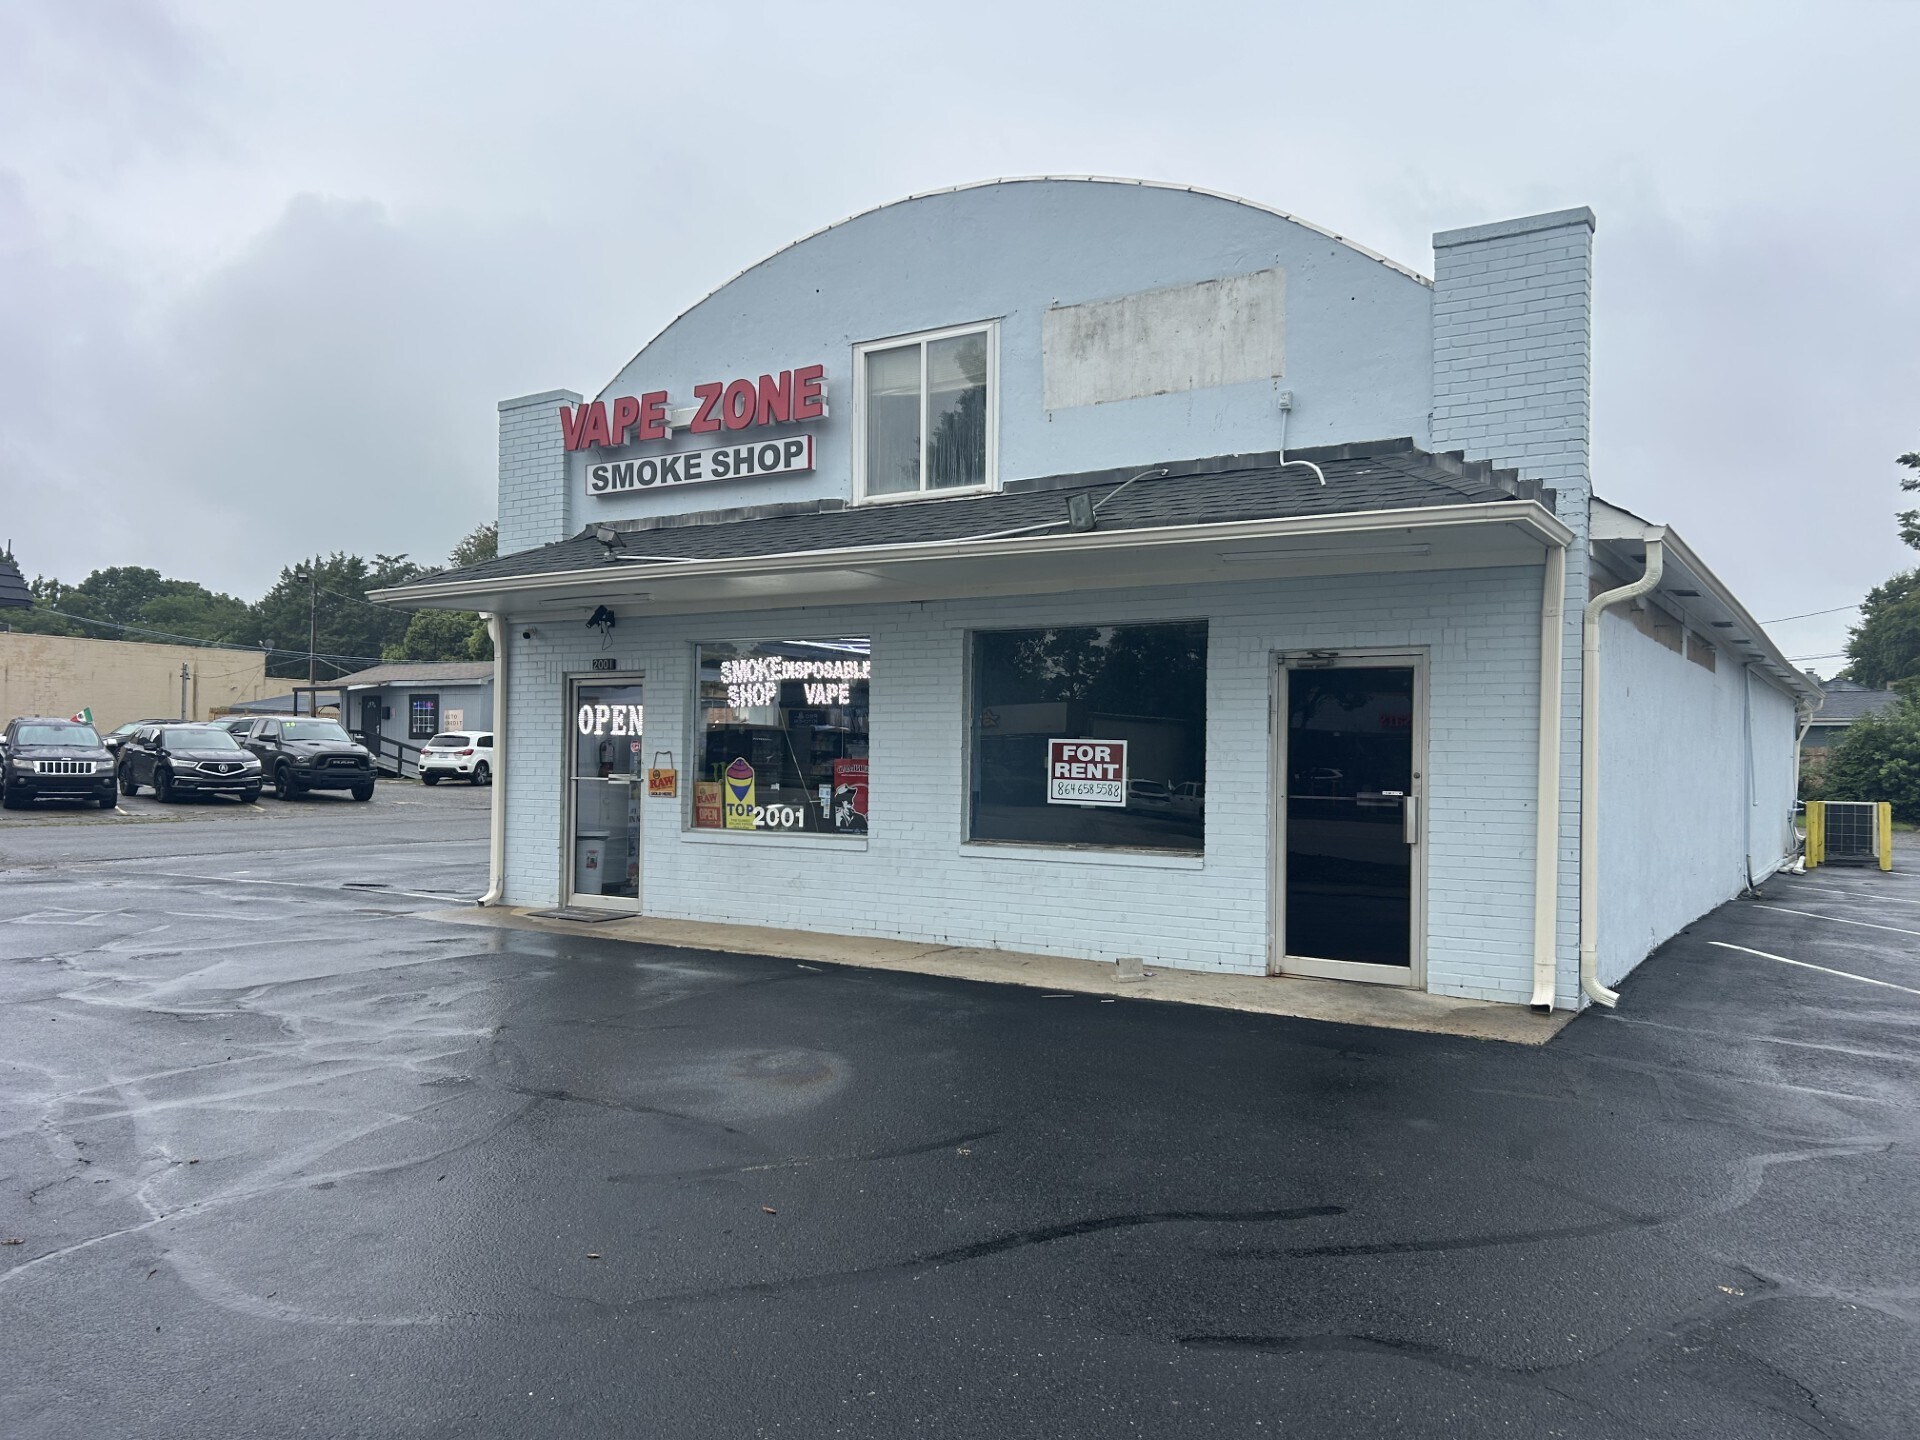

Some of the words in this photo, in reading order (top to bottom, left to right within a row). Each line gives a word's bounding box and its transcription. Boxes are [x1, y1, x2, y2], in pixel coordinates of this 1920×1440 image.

[559, 390, 671, 451] VAPE
[690, 364, 828, 434] ZONE
[591, 452, 702, 491] SMOKE
[711, 440, 804, 478] SHOP
[593, 660, 612, 670] 2001
[720, 656, 782, 684] SMOKE
[727, 682, 777, 708] SHOP
[804, 683, 850, 705] VAPE
[578, 704, 643, 736] OPEN
[1063, 745, 1111, 762] FOR
[1054, 762, 1119, 780] RENT
[649, 775, 675, 789] RAW
[1058, 782, 1076, 795] 864
[1077, 783, 1094, 794] 658
[1096, 783, 1120, 797] 5588
[697, 793, 718, 804] RAW
[698, 808, 718, 821] OPEN
[727, 803, 754, 816] TOP
[752, 806, 804, 828] 2001
